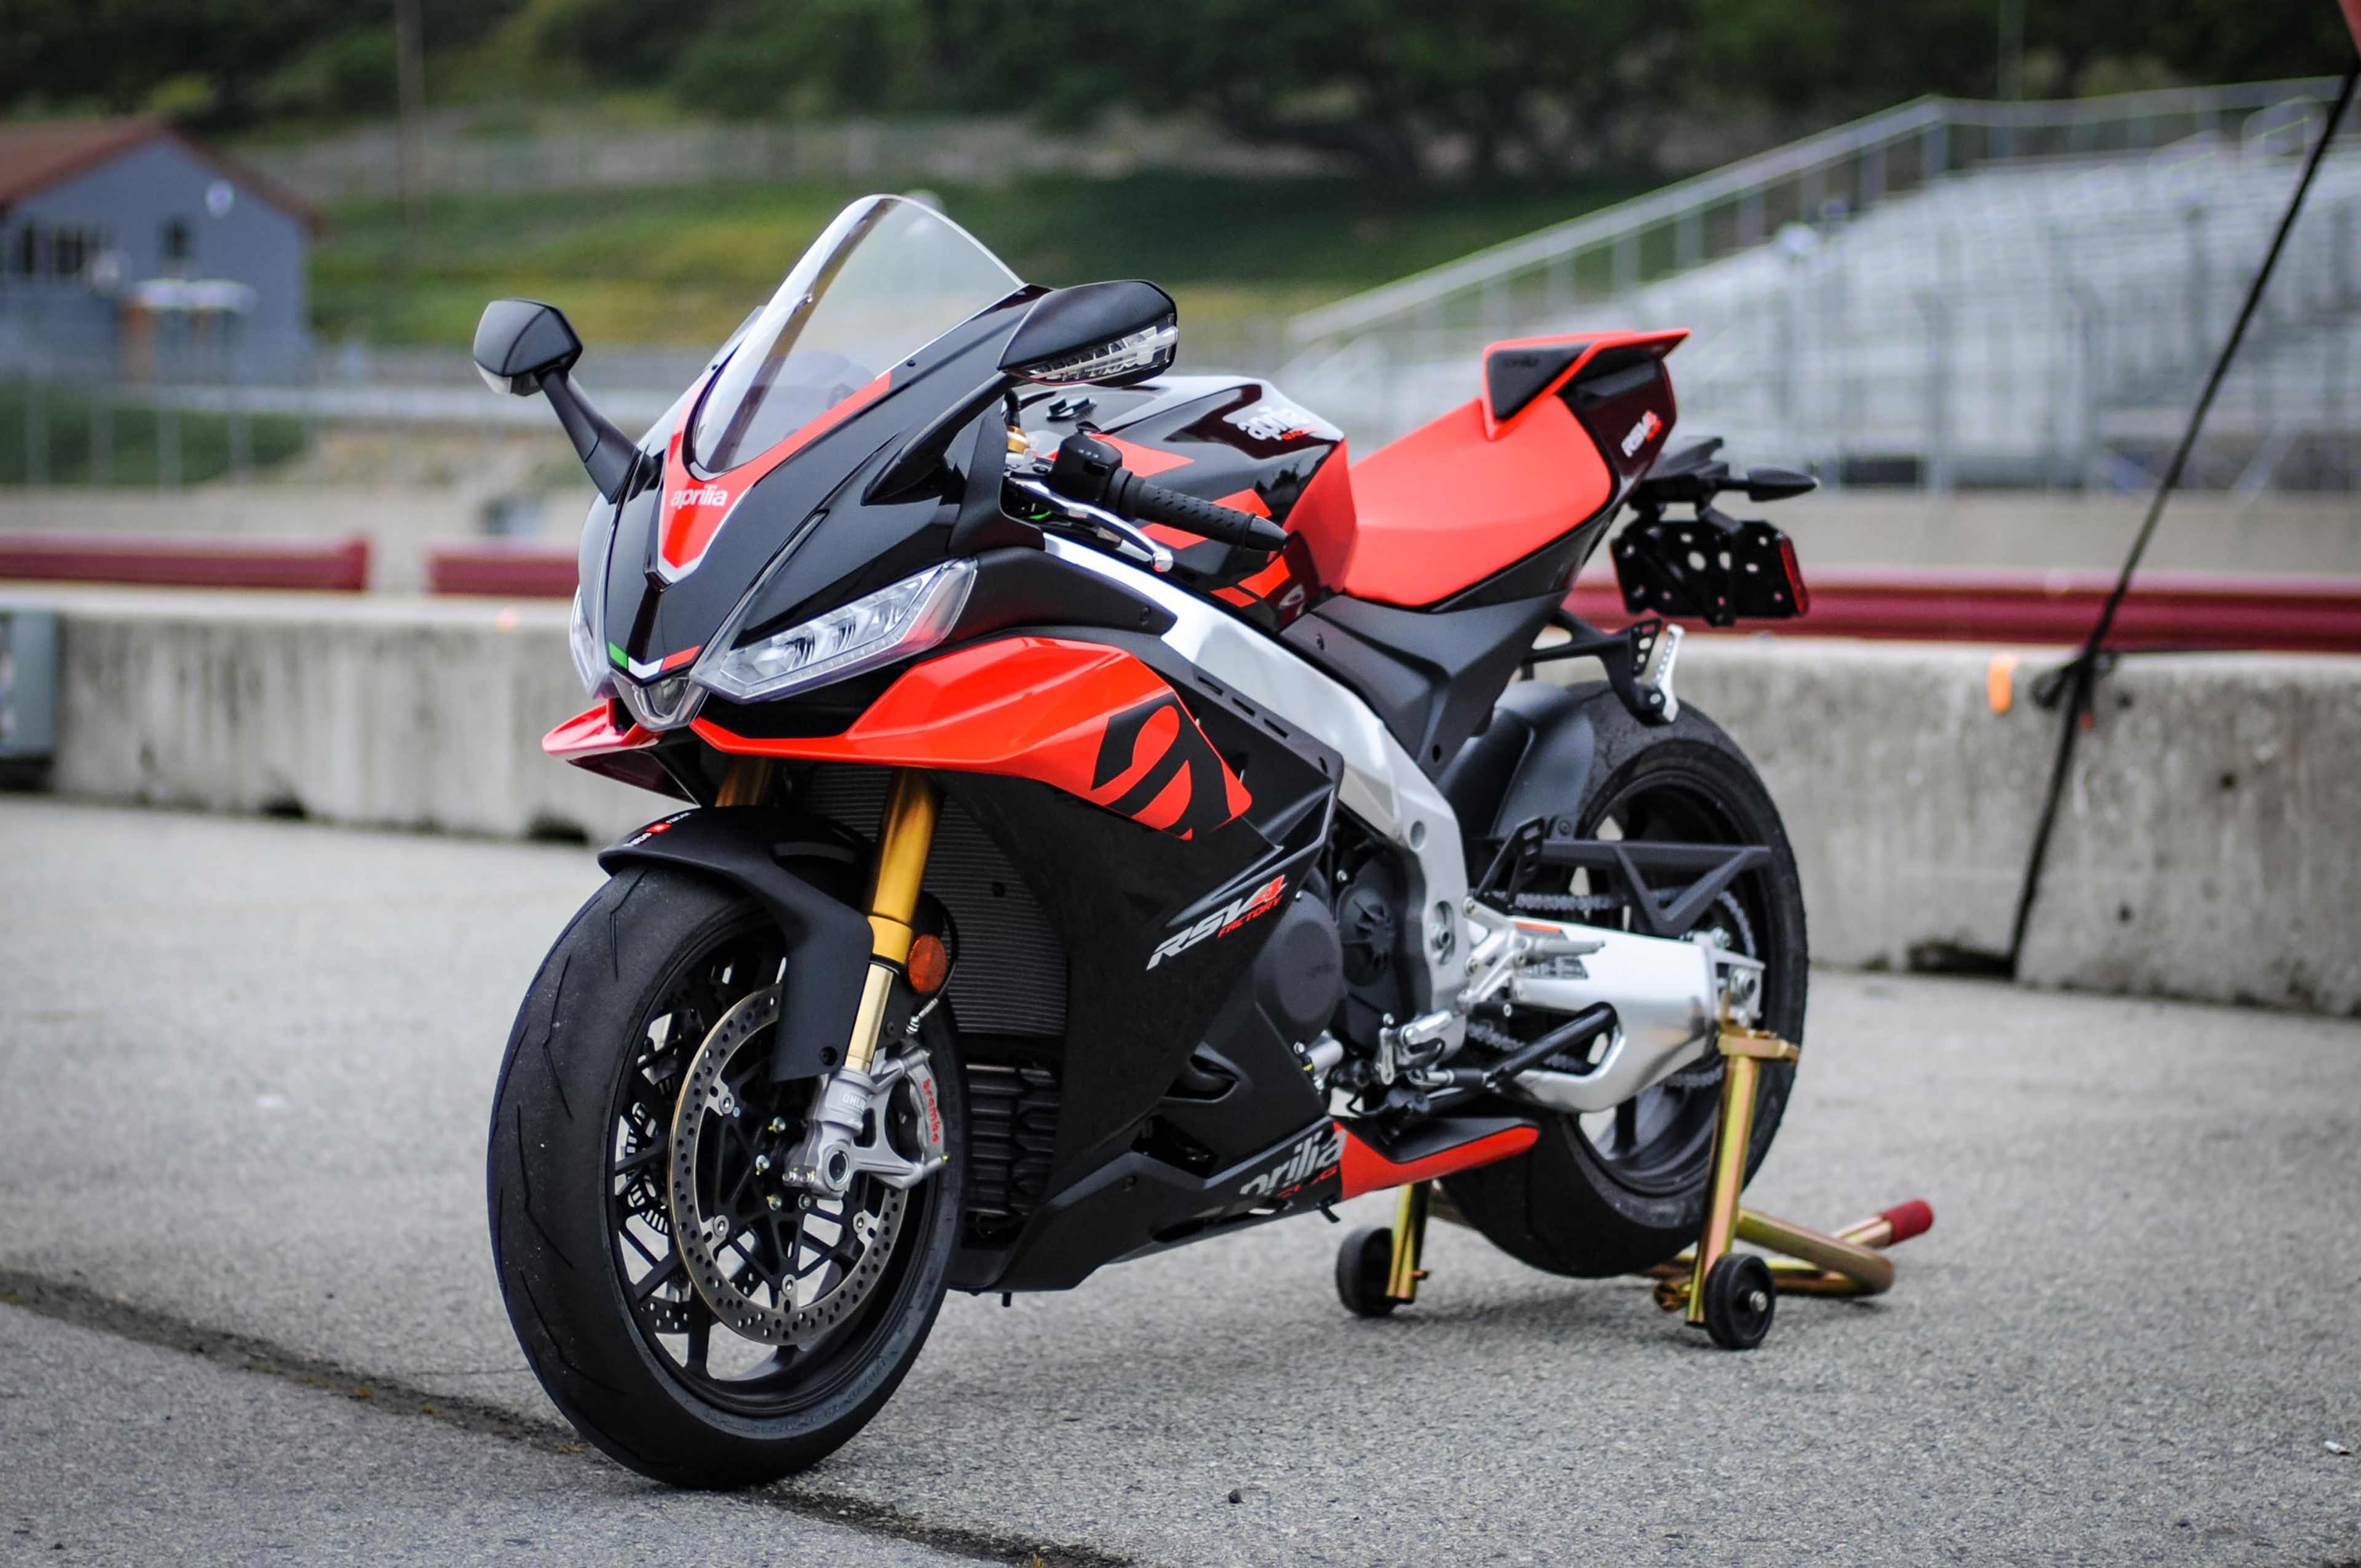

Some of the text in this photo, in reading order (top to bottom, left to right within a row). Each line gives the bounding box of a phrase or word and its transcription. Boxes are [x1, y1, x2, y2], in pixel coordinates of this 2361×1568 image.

[670, 484, 727, 510] aprilia
[1145, 874, 1288, 971] RSV4
[1217, 894, 1283, 939] FACTORY
[923, 1078, 941, 1144] brembo
